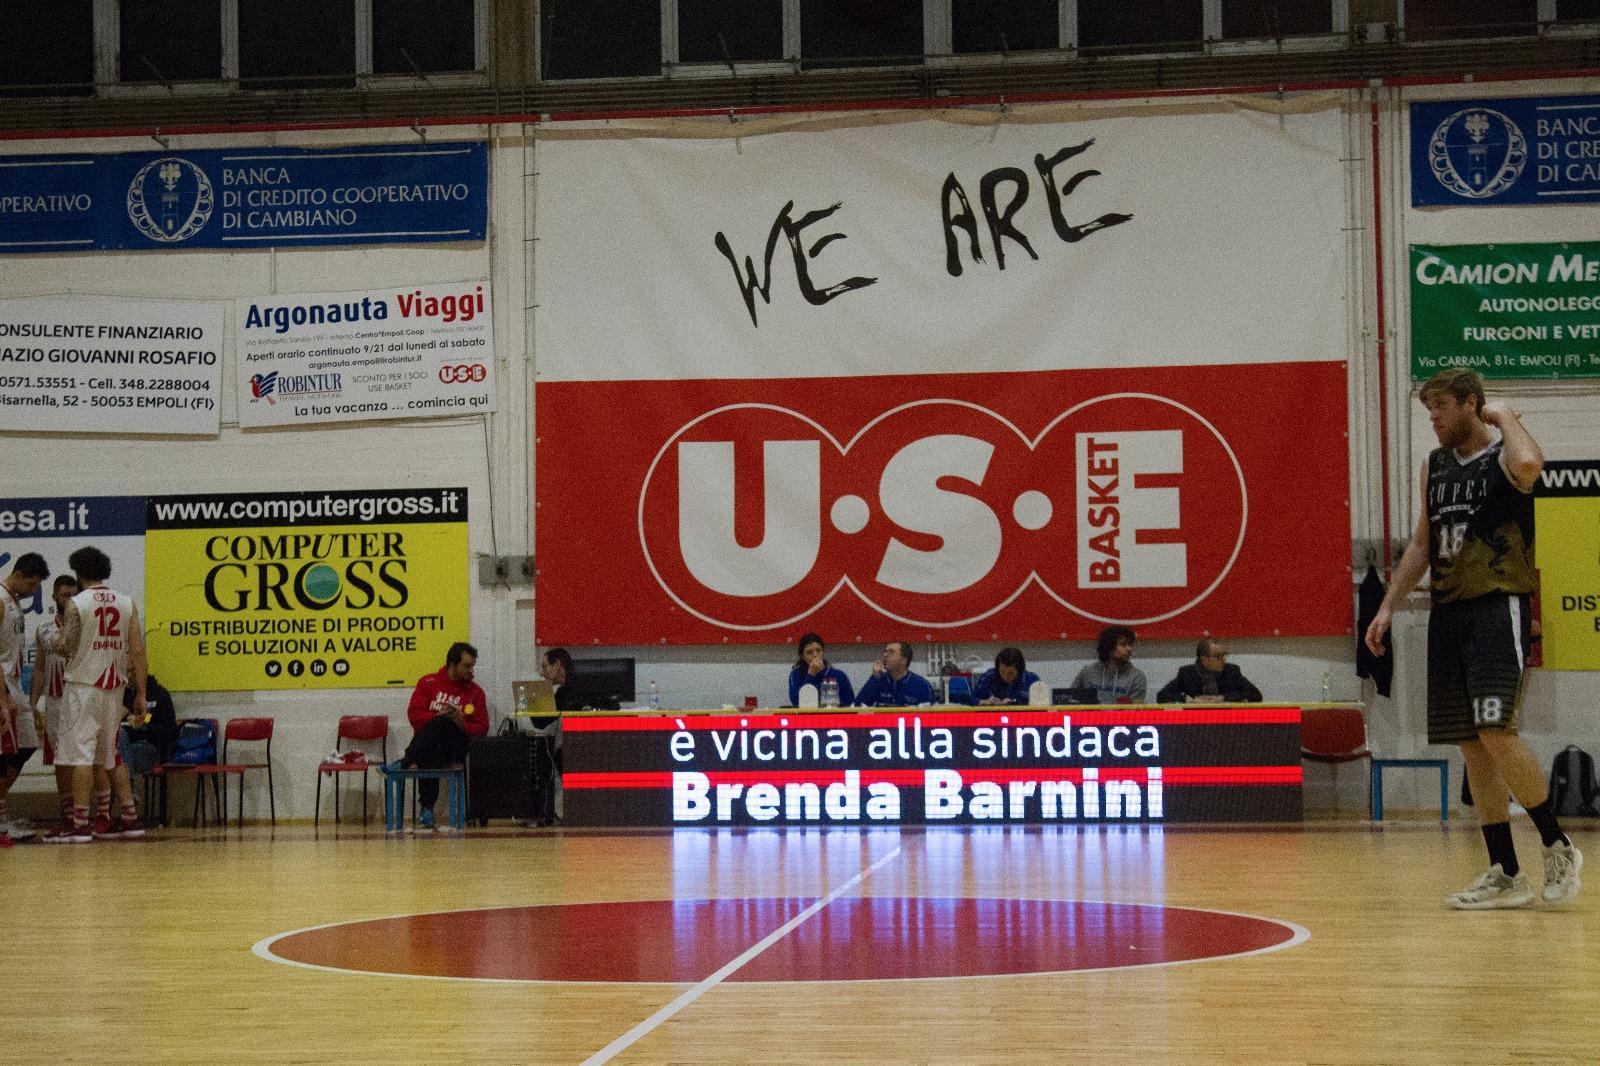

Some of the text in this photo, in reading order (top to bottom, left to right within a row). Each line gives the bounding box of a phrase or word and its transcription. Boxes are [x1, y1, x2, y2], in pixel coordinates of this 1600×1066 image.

[1536, 117, 1600, 137] BANC
[1538, 142, 1559, 159] DI
[222, 167, 291, 186] BANCA
[1538, 164, 1559, 182] DI
[0, 194, 92, 213] PERATIVO
[222, 183, 469, 207] DI CREDITO COOPERATIVO
[222, 208, 357, 229] DI CAMBIANO
[715, 138, 1133, 328] WE ARE
[1415, 254, 1600, 285] CAMION ME
[246, 286, 484, 333] Argonauta Viaggi
[99, 326, 203, 340] FINANZIARIO
[1463, 326, 1547, 341] FURGONI
[1554, 325, 1563, 338] E
[0, 348, 217, 365] AZIO GIOVANNI ROSAFIO
[246, 352, 275, 362] Aperti
[277, 350, 305, 360] orario
[309, 347, 361, 358] continuato
[364, 344, 385, 354] 9/21
[388, 343, 404, 352] dal
[439, 339, 449, 349] al
[451, 338, 486, 348] sabato
[1418, 356, 1436, 367] Via
[1440, 355, 1490, 369] CARRAIA,
[1520, 355, 1561, 366] EMPOLI
[88, 378, 117, 390] Cell.
[120, 379, 211, 391] 348.2288004
[278, 373, 343, 393] ROBINTUR
[352, 374, 387, 383] SCONTO
[388, 372, 403, 382] PER
[409, 371, 429, 380] SOCI
[368, 382, 412, 392] USE BASKET
[63, 396, 79, 406] 52
[90, 396, 134, 407] 50053
[137, 397, 188, 409] EMPOLI
[191, 397, 215, 411] (FI)
[294, 405, 308, 416] La
[312, 403, 332, 415] tua
[335, 402, 388, 414] vacanza
[408, 397, 466, 409] comincia
[470, 394, 489, 408] qui
[156, 489, 460, 523] www.computergross.it
[1087, 437, 1121, 584] BASKET
[0, 502, 89, 532] esa.it
[205, 532, 407, 562] COMPUTER
[204, 559, 409, 613] GROSS
[94, 606, 121, 637] 12
[170, 615, 445, 637] DISTRIBUZIONE DI PRODOTTI
[198, 635, 417, 656] E SOLUZIONI A VALORE
[1473, 697, 1503, 726] 18
[670, 715, 1161, 762] è vicina alla sindaca
[672, 766, 1164, 823] Brenda Barnini
